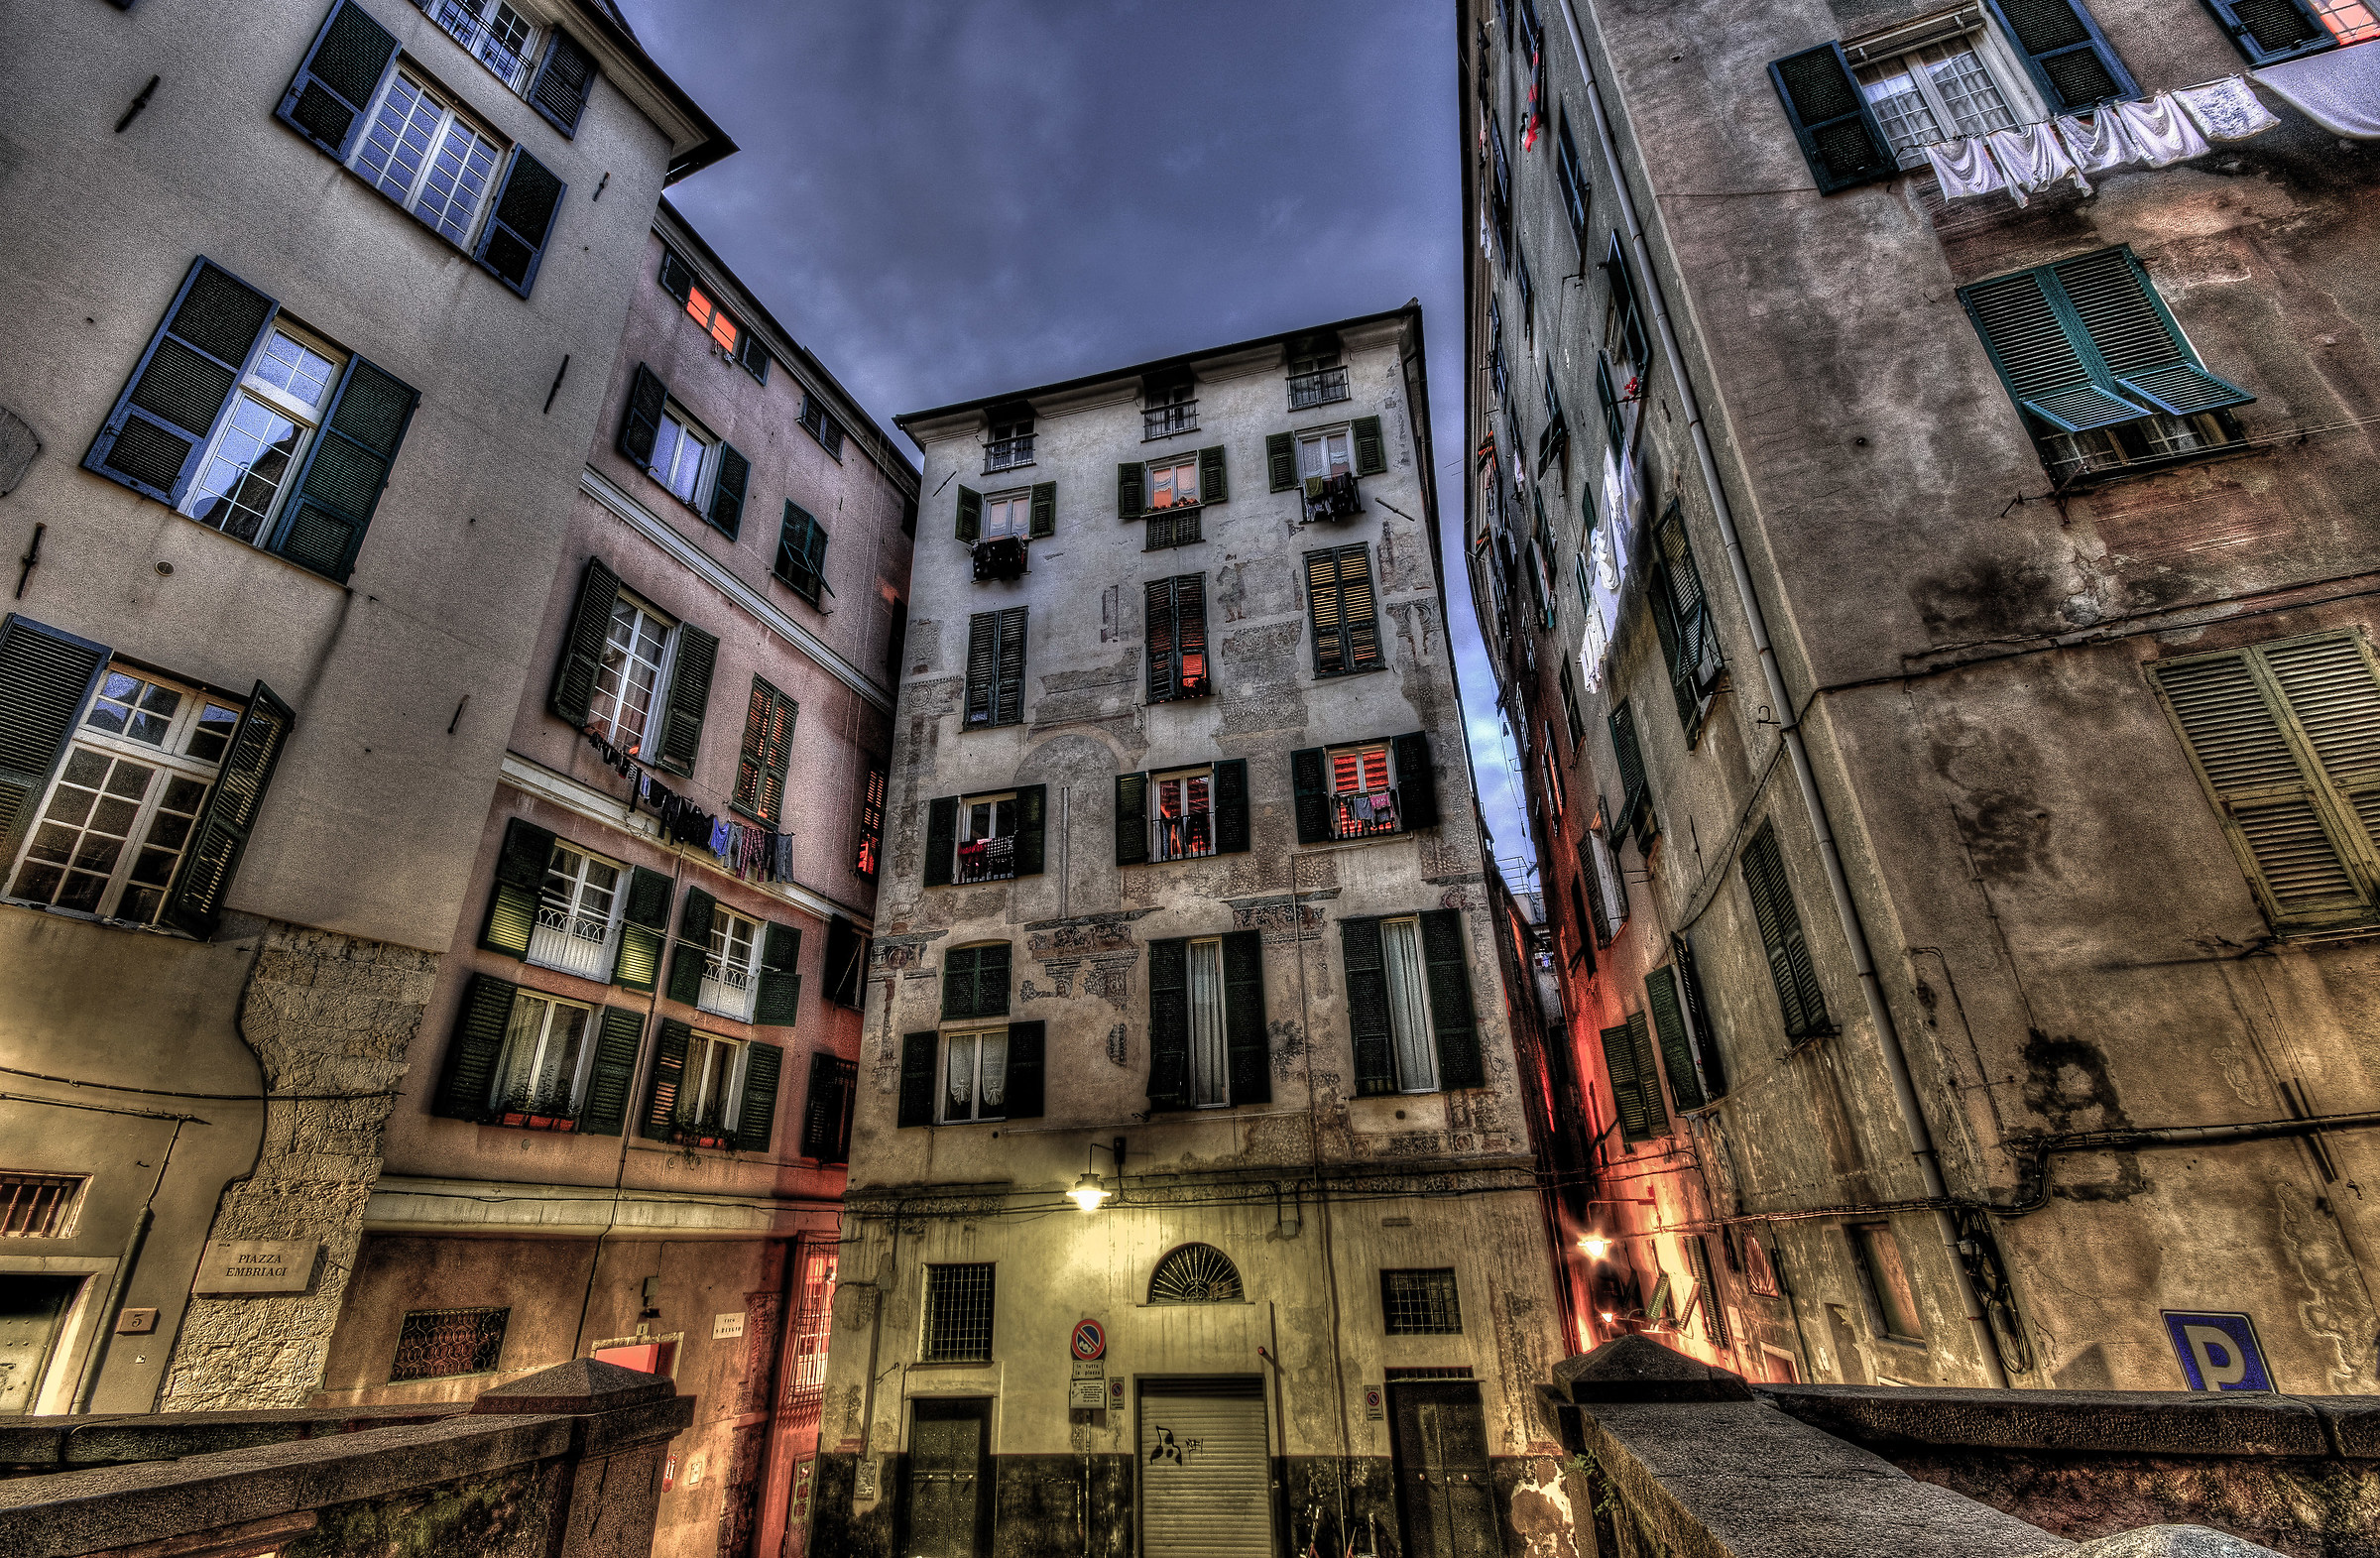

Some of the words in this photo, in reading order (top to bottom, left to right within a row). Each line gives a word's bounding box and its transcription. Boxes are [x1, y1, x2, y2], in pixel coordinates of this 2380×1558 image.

[238, 1255, 282, 1263] PIAZZA
[225, 1267, 288, 1277] EMBRIACI
[132, 1313, 145, 1328] 5
[2183, 1325, 2246, 1392] P
